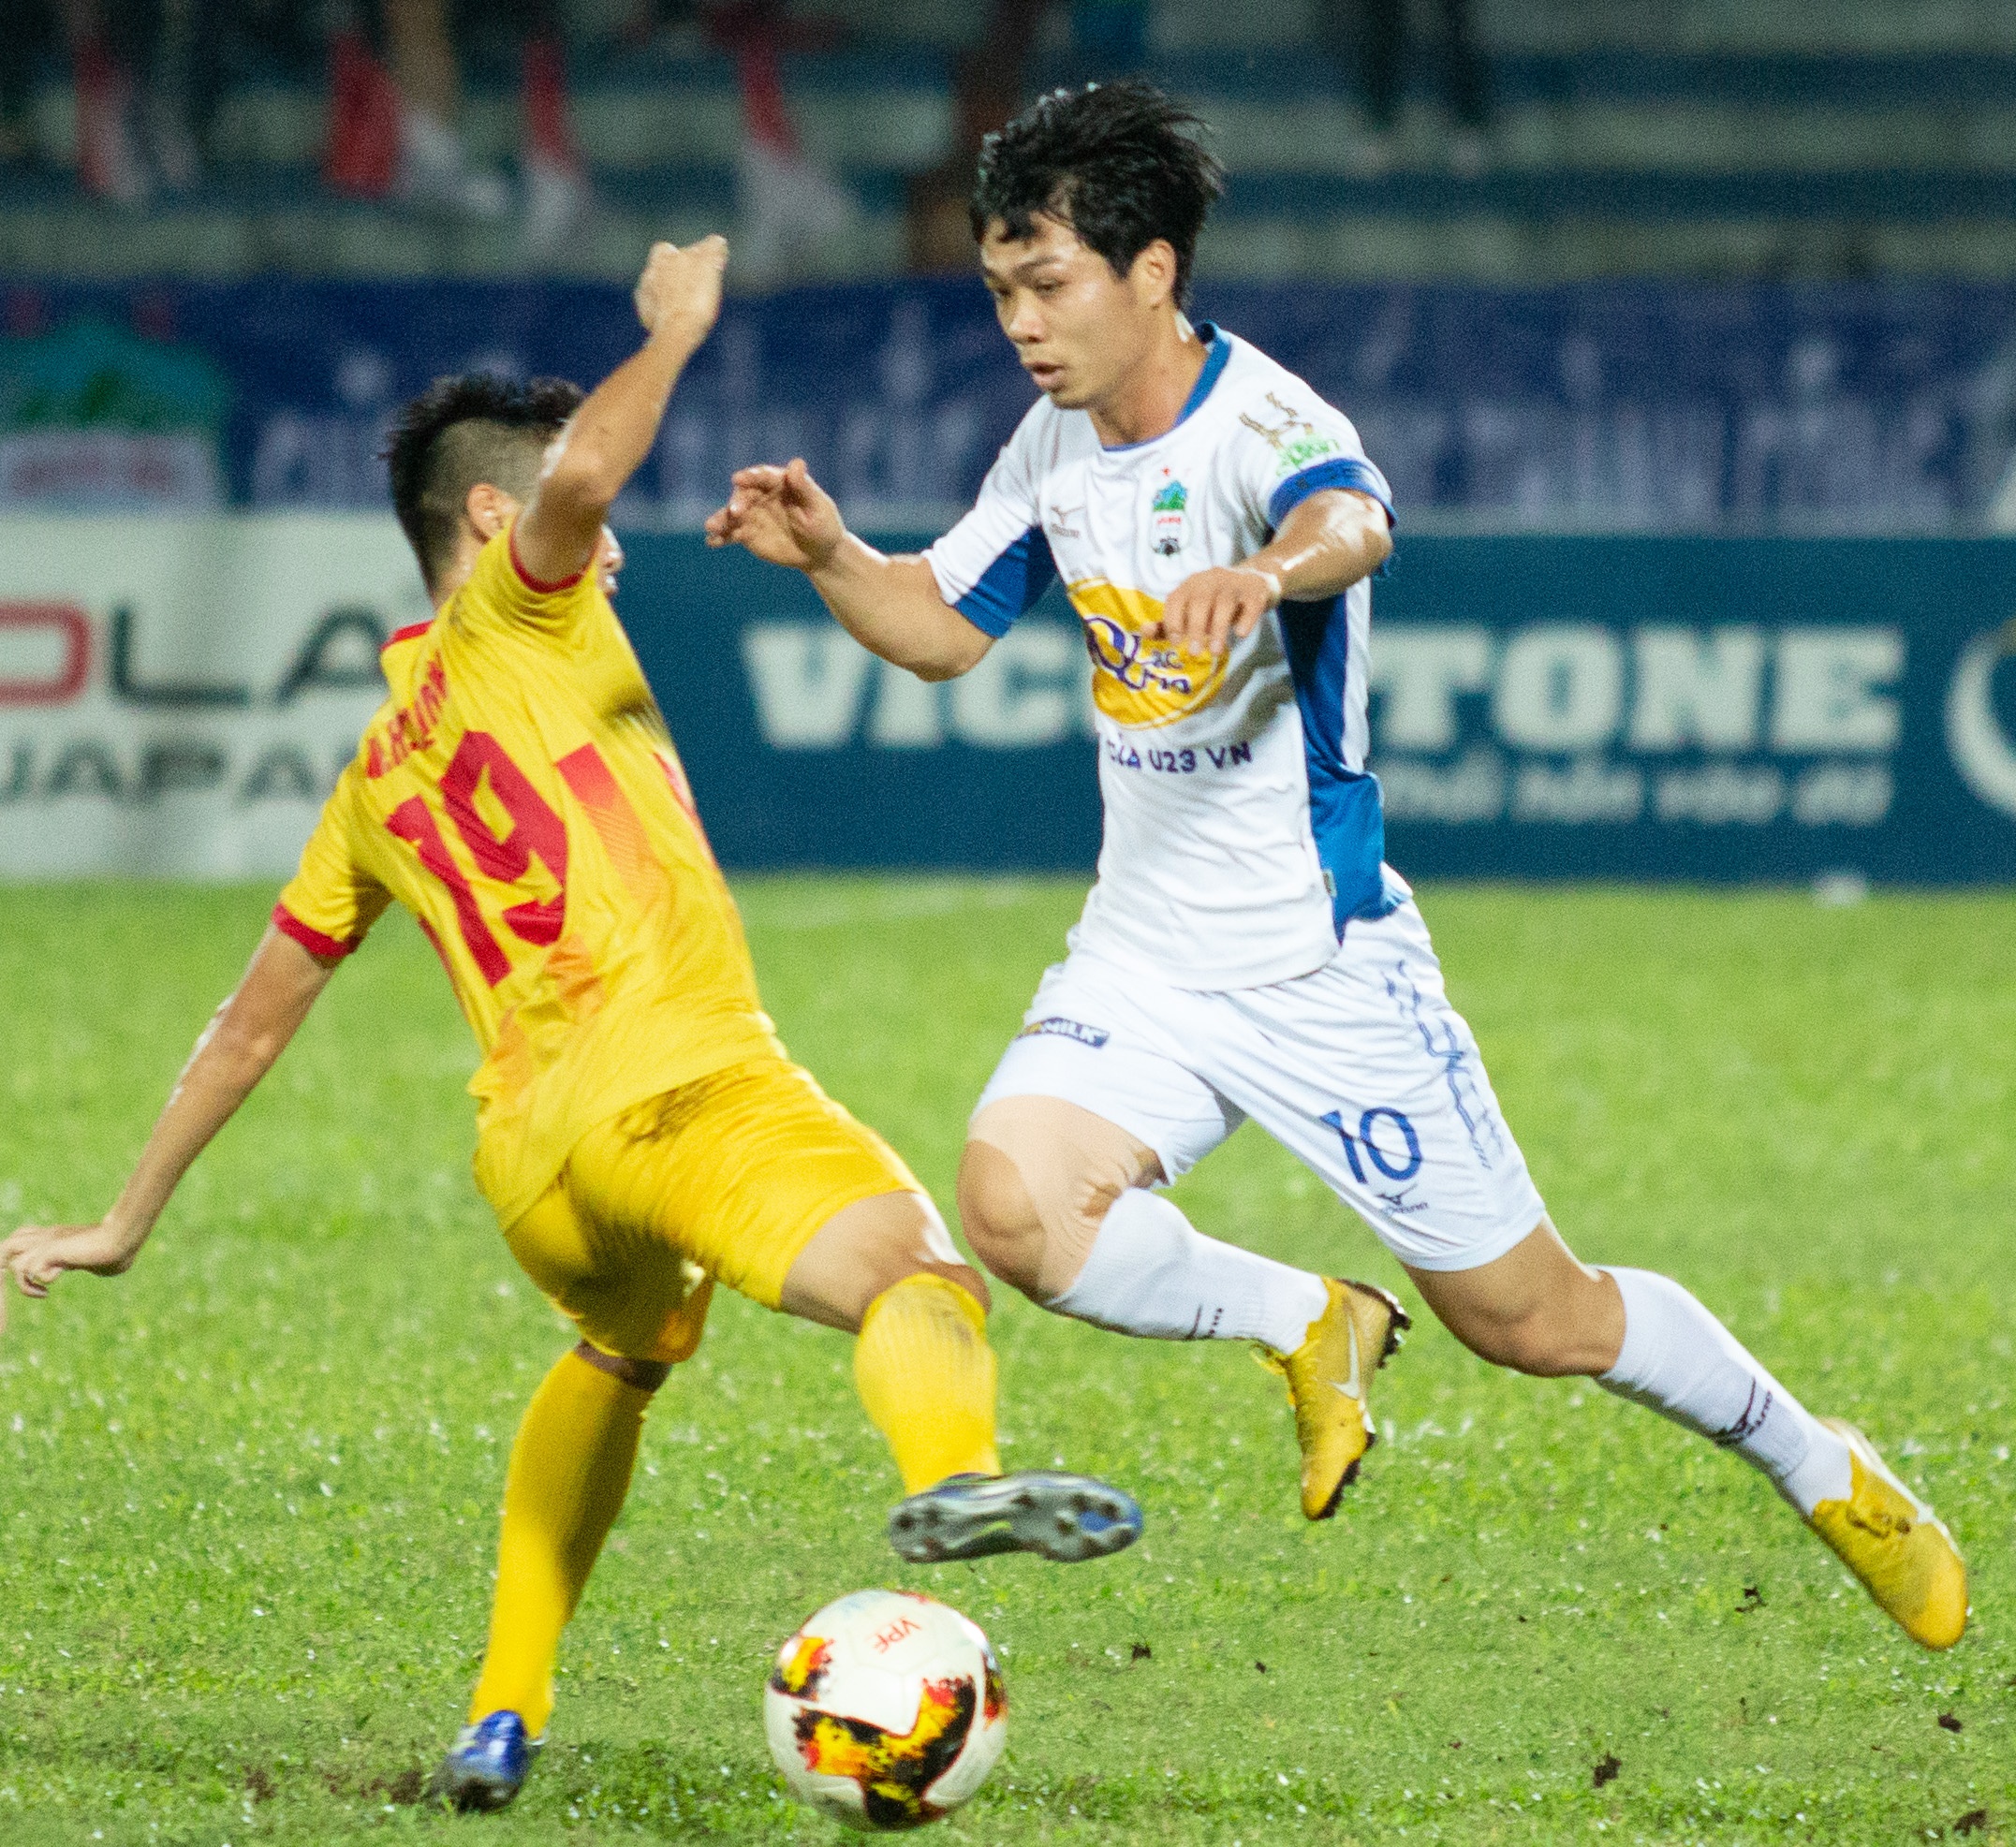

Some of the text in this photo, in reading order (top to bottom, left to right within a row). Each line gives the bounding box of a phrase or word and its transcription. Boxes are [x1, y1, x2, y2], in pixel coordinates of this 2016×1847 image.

[1149, 748, 1197, 773] U23
[1204, 740, 1253, 770] VN
[384, 729, 568, 989] 19
[1319, 1107, 1422, 1184] 10
[872, 1615, 922, 1654] VPF
